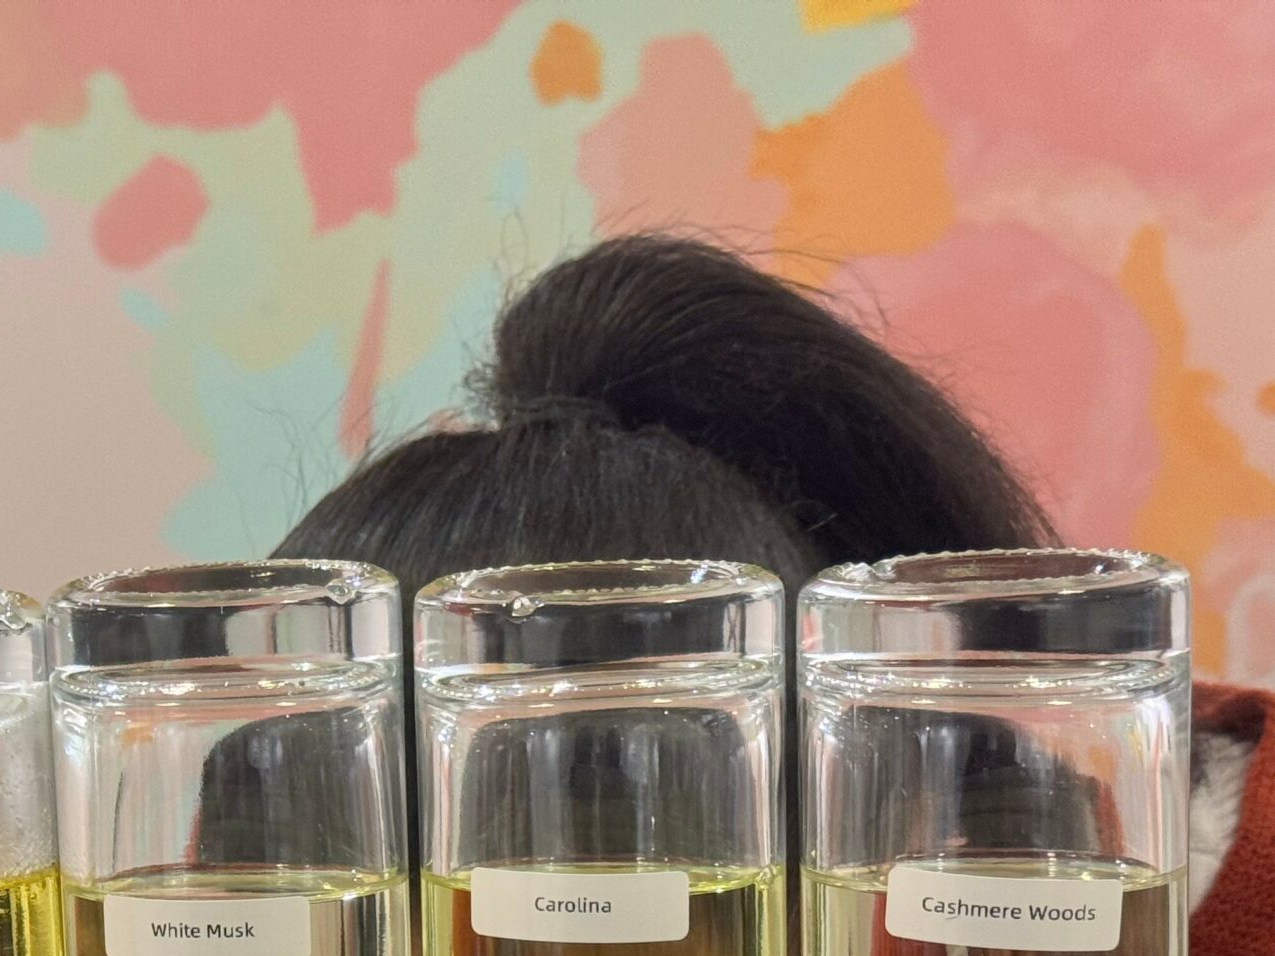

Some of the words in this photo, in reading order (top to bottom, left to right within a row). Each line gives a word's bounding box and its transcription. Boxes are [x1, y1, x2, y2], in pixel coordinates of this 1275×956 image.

[534, 896, 612, 914] Carolina
[922, 896, 1022, 920] Cashmere
[1029, 904, 1096, 921] Woods
[151, 922, 201, 938] White
[206, 922, 255, 938] Musk
